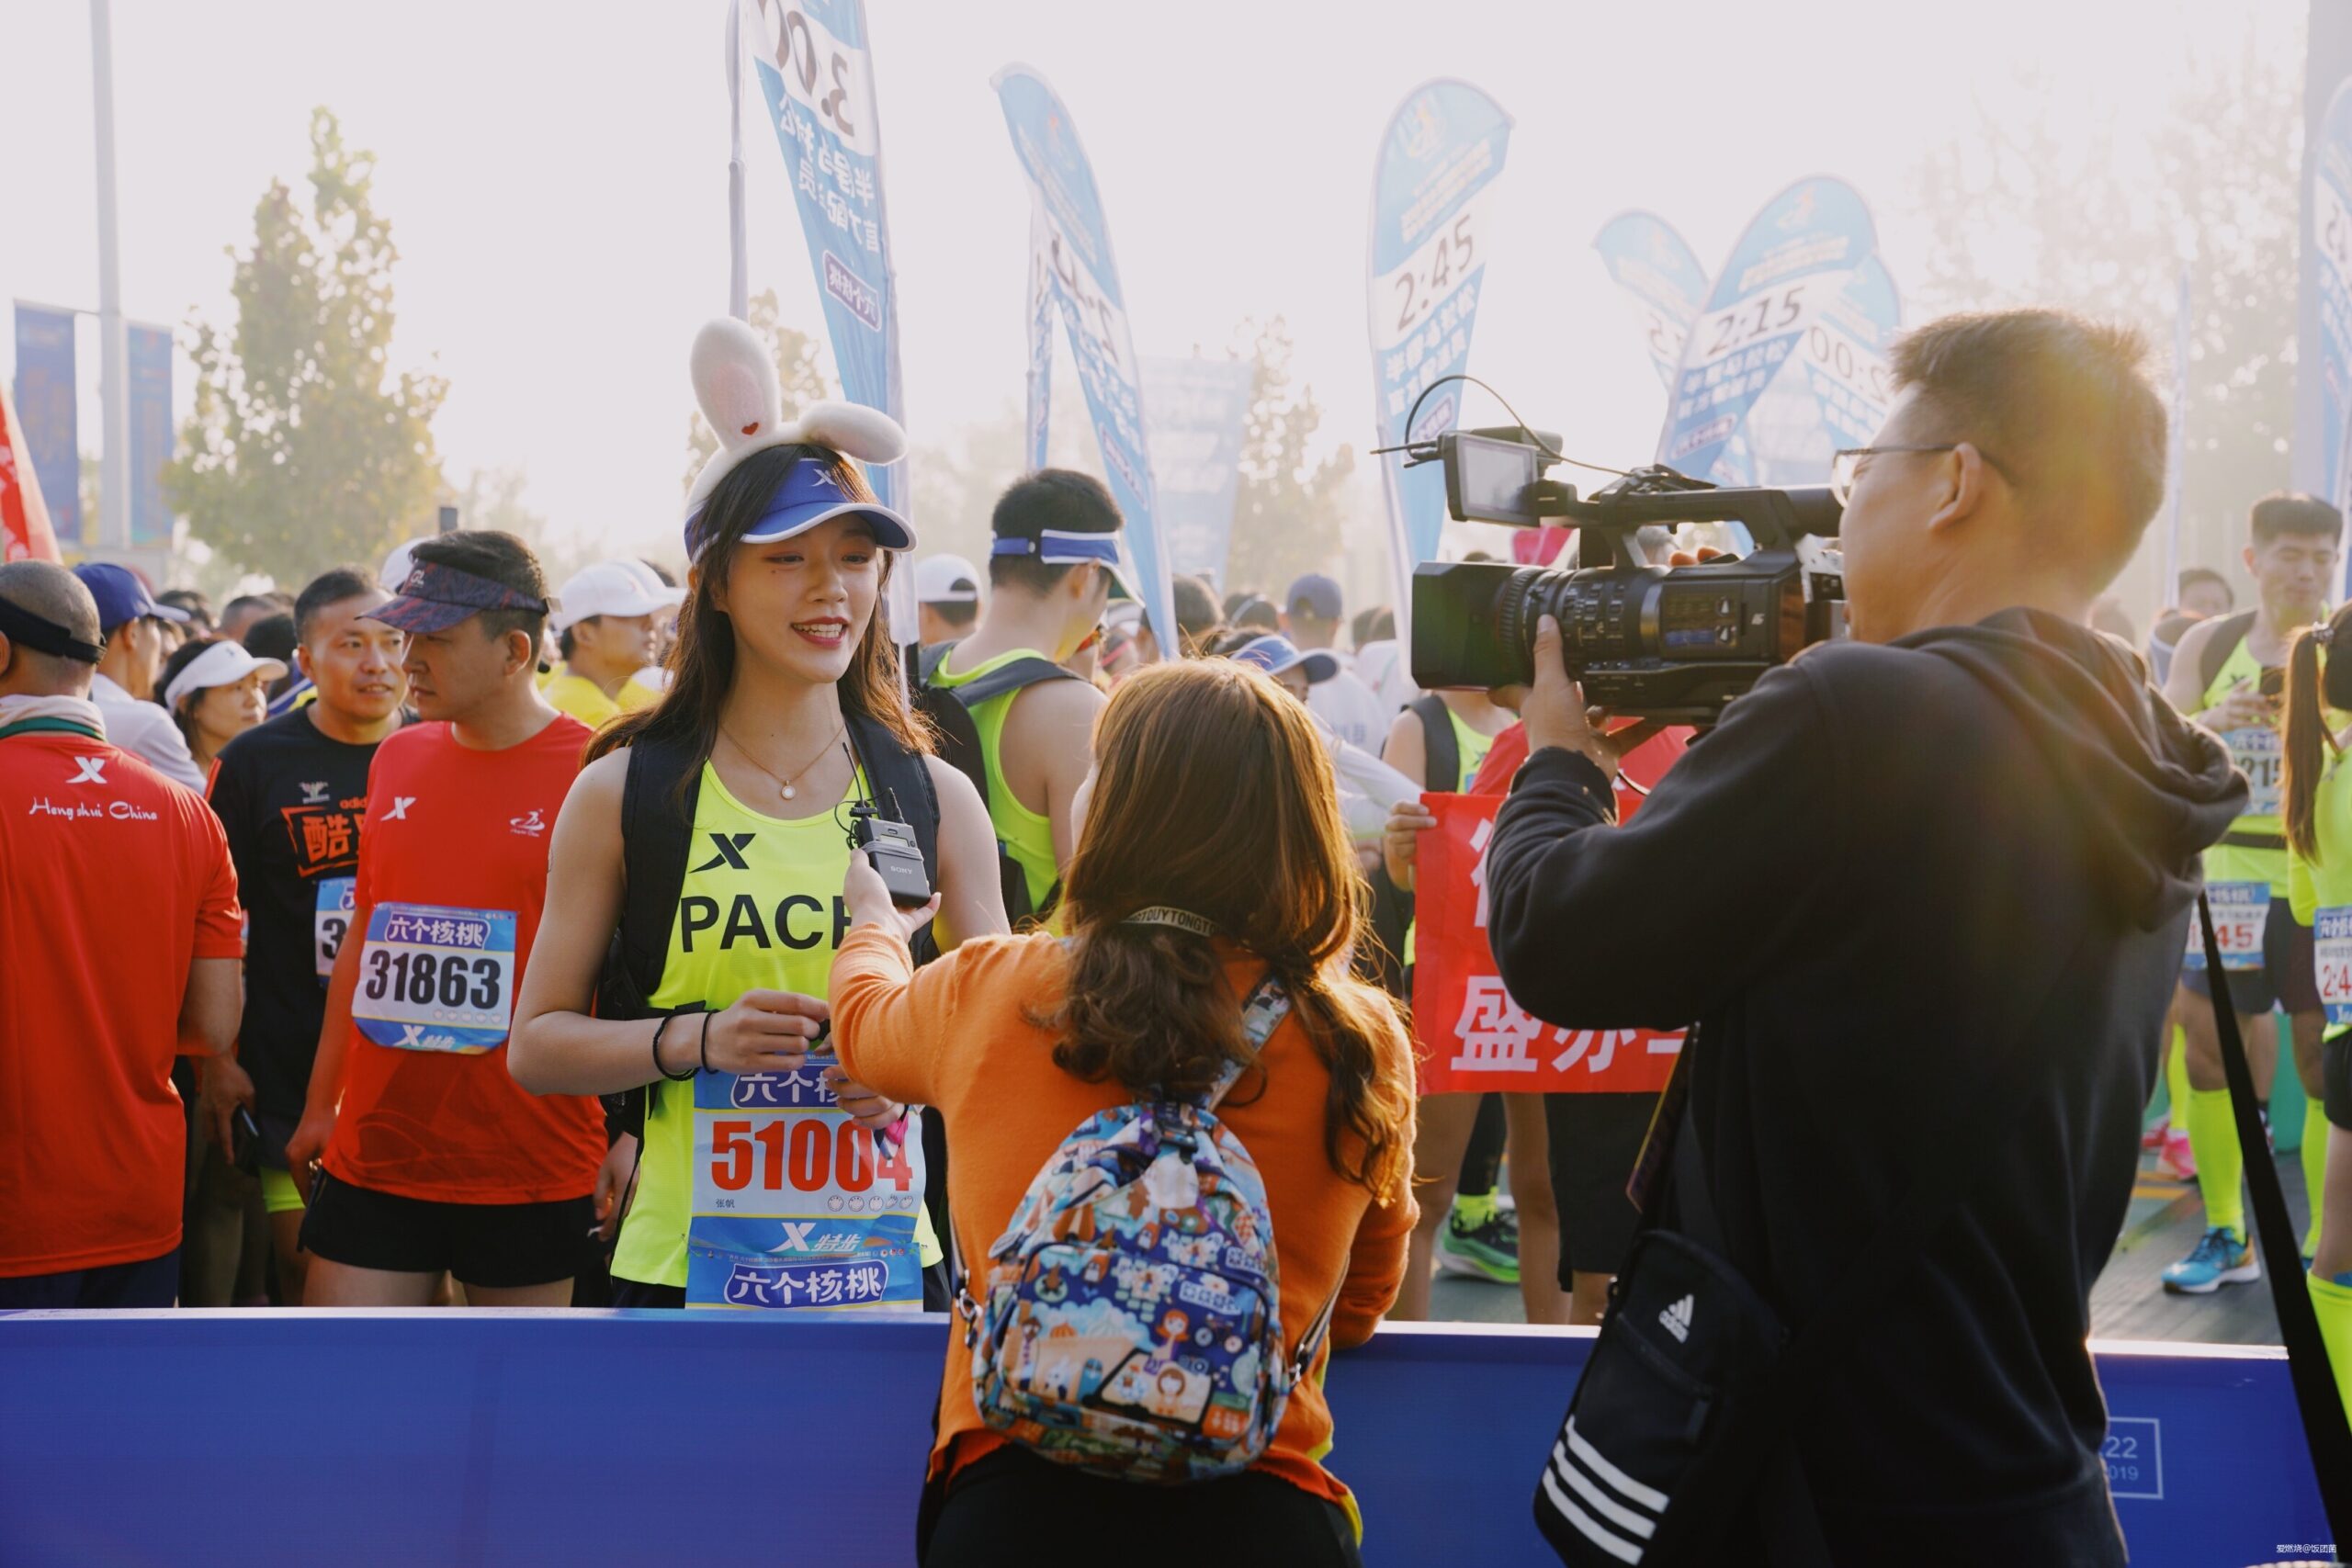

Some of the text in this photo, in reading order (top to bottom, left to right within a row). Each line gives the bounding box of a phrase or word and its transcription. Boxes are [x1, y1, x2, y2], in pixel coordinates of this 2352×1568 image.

[1395, 213, 1474, 332] 2:45
[1706, 286, 1805, 357] 2:15
[890, 865, 913, 874] SONY
[389, 917, 484, 948] 六个核桃
[366, 949, 502, 1010] 31863
[711, 1119, 913, 1192] 51004
[810, 1233, 862, 1252] 特步
[731, 1267, 884, 1304] 六个核桃
